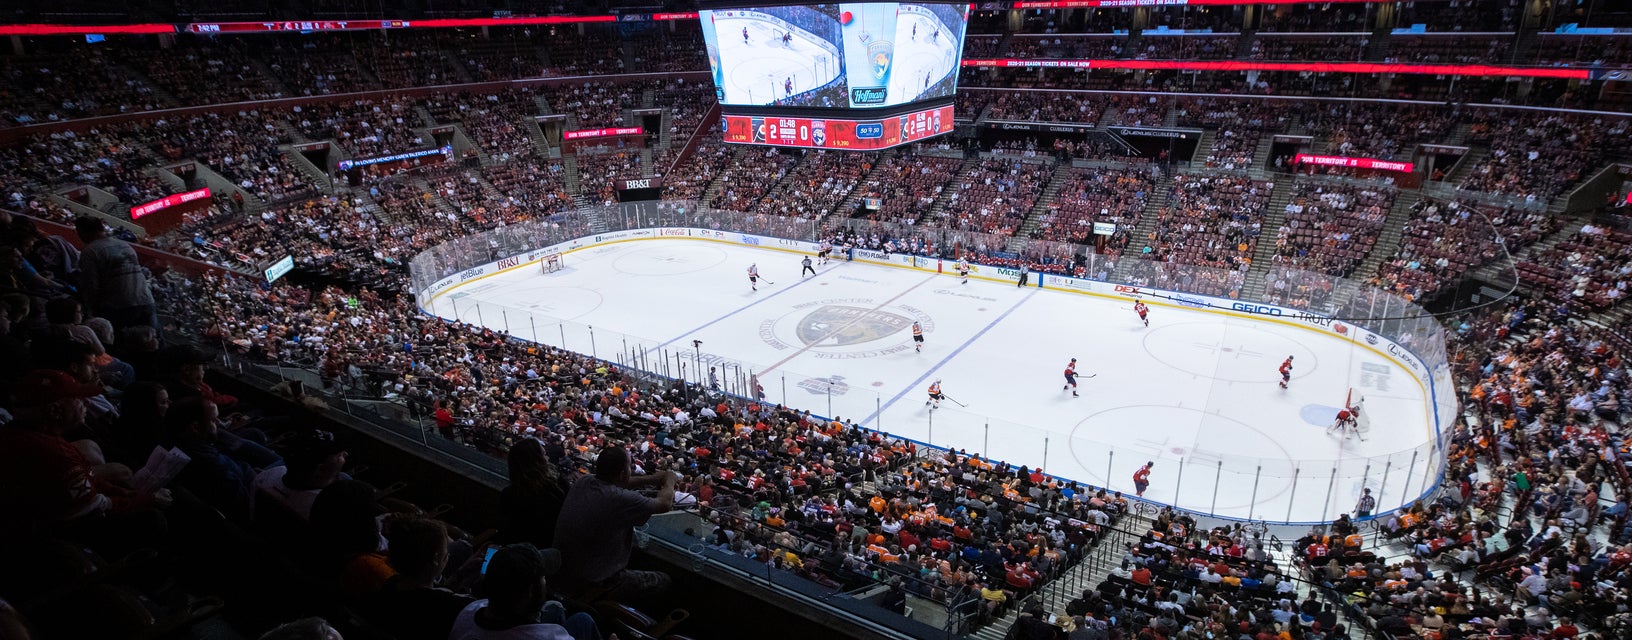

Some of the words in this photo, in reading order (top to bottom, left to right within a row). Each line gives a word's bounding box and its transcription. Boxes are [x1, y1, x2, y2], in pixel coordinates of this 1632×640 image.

[770, 124, 777, 138] 2
[780, 120, 796, 128] 01:48
[801, 126, 807, 140] 0
[910, 120, 915, 135] 2
[928, 117, 931, 130] 0
[1372, 162, 1406, 170] TERRITORY
[626, 179, 651, 189] BB&T
[497, 256, 520, 270] BB&T
[460, 268, 484, 282] jetBlue
[1114, 285, 1140, 294] DEX
[1233, 302, 1282, 316] GEICO
[1299, 311, 1332, 327] TRULY
[1399, 351, 1418, 370] LEXUS
